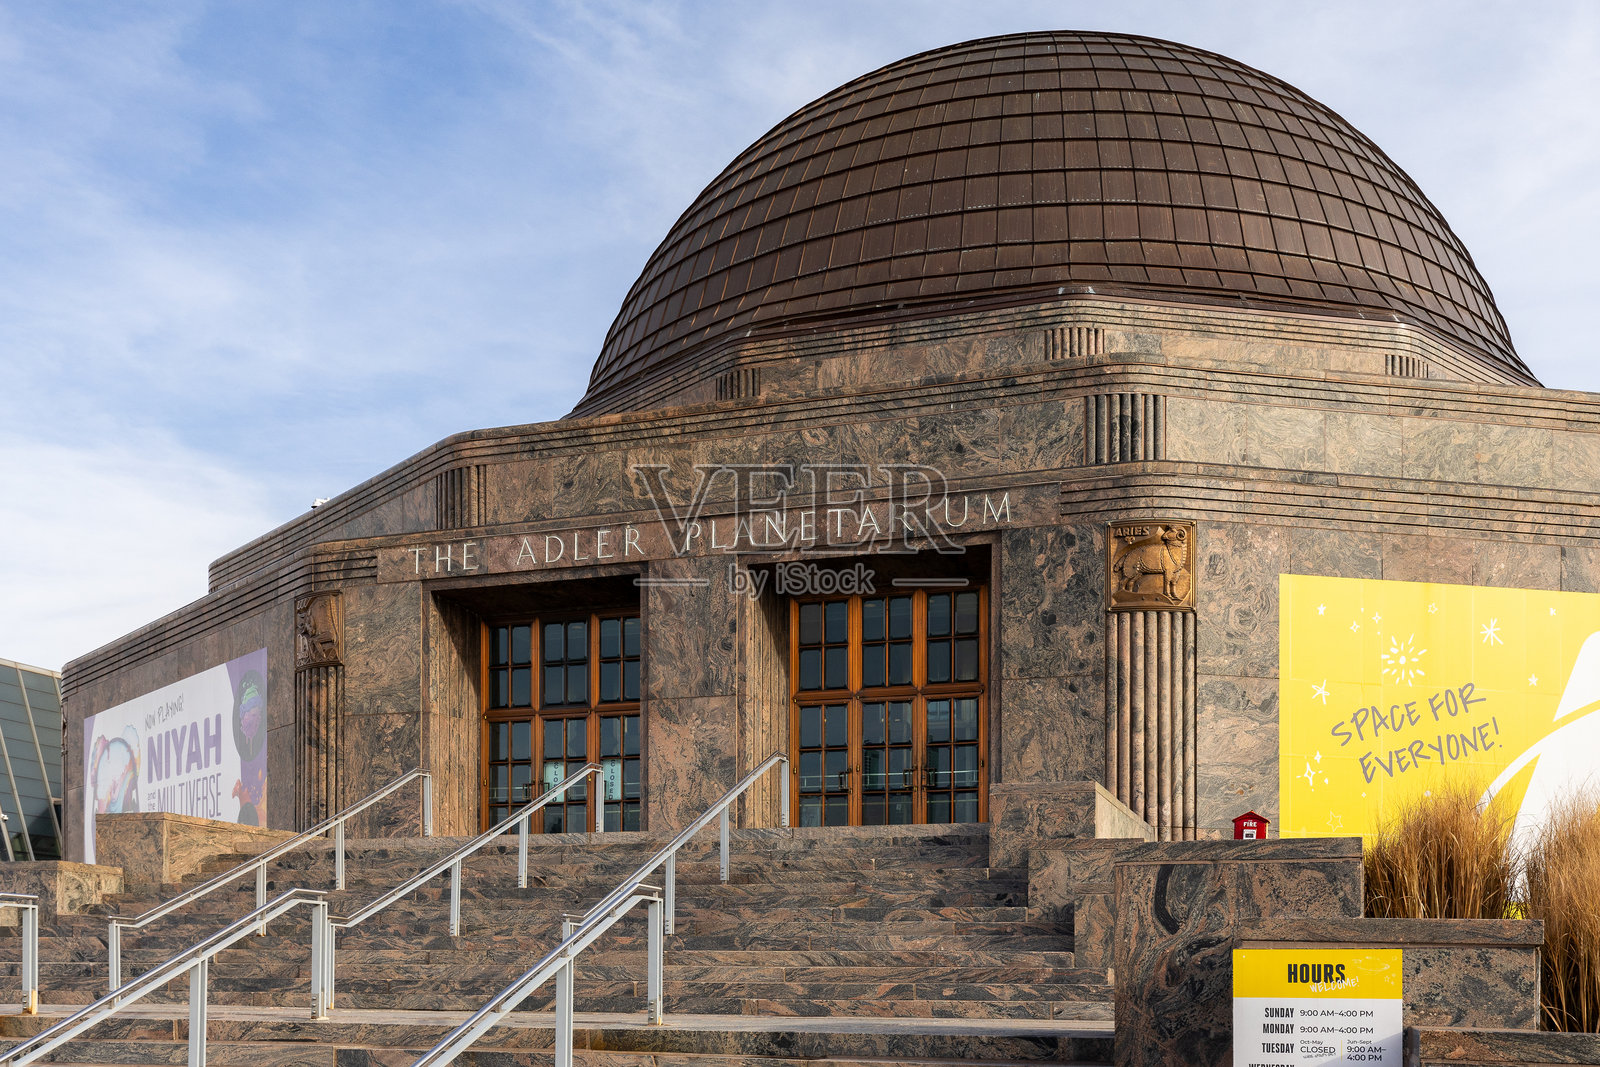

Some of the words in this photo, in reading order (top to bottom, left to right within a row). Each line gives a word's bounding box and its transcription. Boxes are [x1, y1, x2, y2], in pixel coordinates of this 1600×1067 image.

[407, 541, 480, 575] THE
[516, 527, 645, 566] ADLER
[685, 491, 1012, 551] PLANETARIUM
[1114, 526, 1150, 537] ARIES
[145, 711, 157, 730] NOW
[158, 692, 184, 724] PLAYING!
[1330, 701, 1421, 747] SPACE
[1428, 682, 1487, 721] FOR
[147, 713, 222, 784] NIYAH
[1358, 716, 1503, 784] EVERYONE!
[147, 791, 157, 801] and
[157, 773, 222, 818] MULTIVERSE
[1287, 963, 1346, 984] HOURS
[1309, 976, 1360, 993] WELCOME!
[1264, 1007, 1294, 1018] SUNDAY
[1300, 1009, 1318, 1017] 9:00
[1262, 1023, 1294, 1034] MONDAY
[1300, 1026, 1318, 1034] 9:00
[1262, 1042, 1294, 1054] TUESDAY
[1300, 1046, 1336, 1054] CLOSED
[1346, 1054, 1366, 1062] 4:00
[1368, 1054, 1382, 1062] PM
